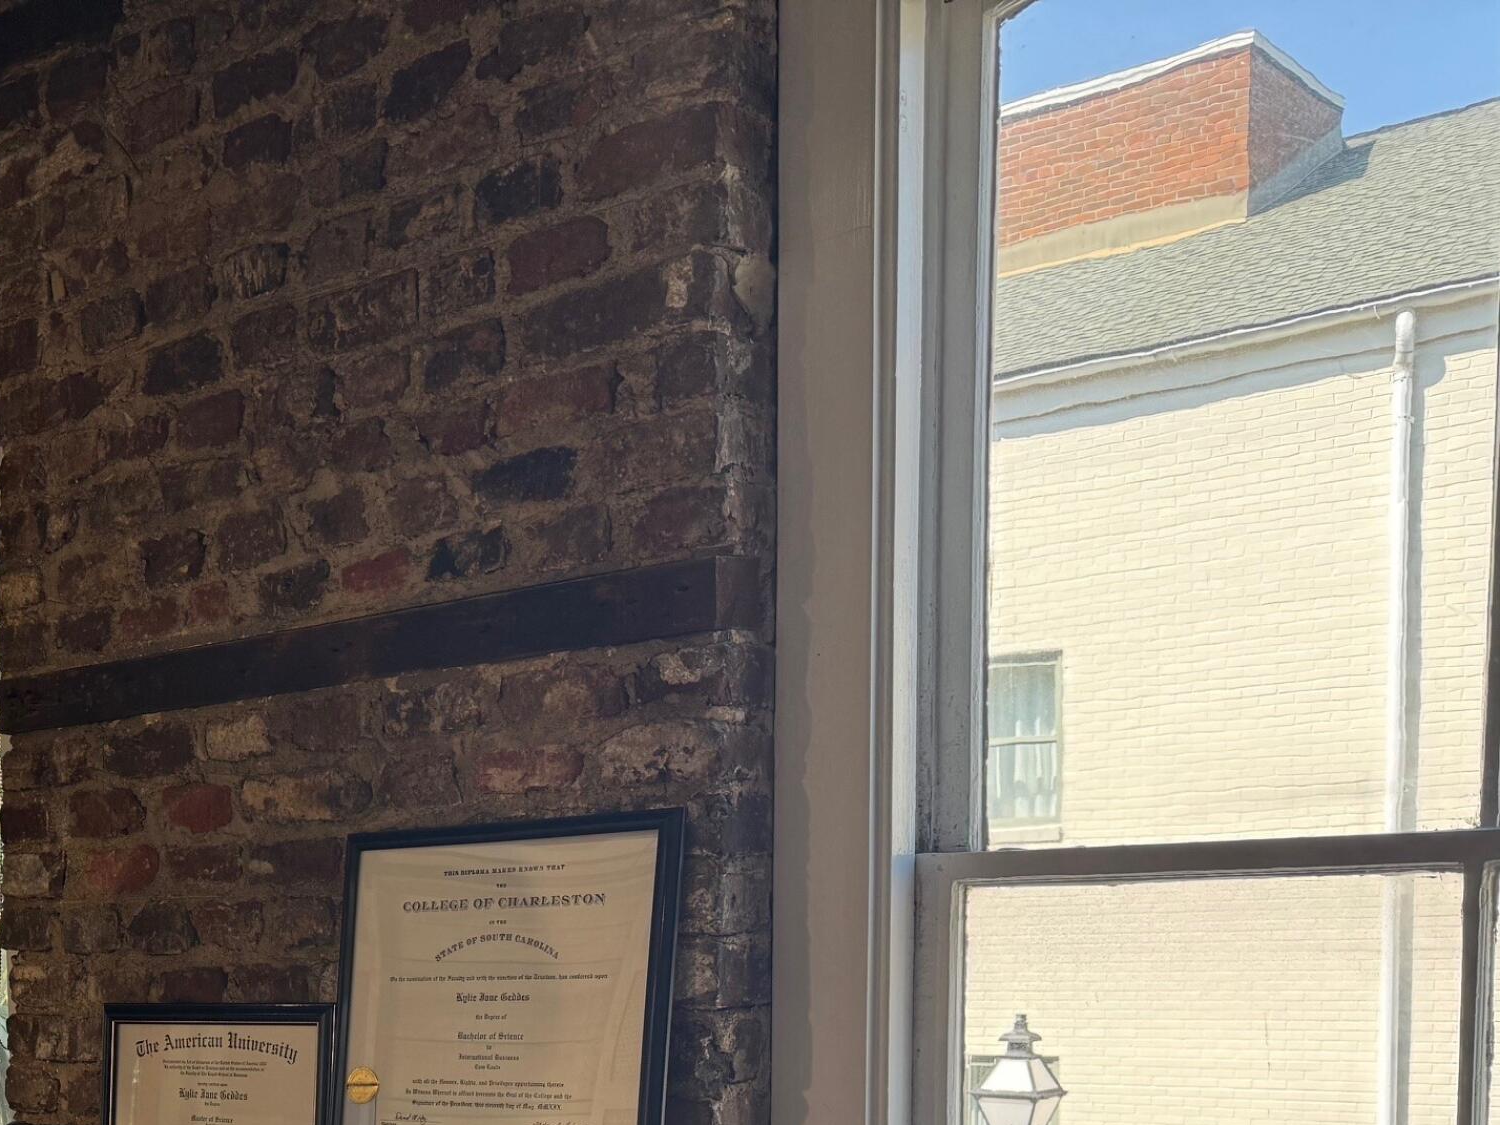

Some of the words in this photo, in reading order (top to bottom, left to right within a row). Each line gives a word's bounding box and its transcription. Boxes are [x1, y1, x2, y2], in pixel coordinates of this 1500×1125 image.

[402, 898, 468, 913] COLLEGE
[472, 898, 494, 910] OF
[497, 893, 606, 910] CHARLESTON
[434, 940, 464, 962] STATE
[466, 936, 478, 946] OF
[480, 933, 512, 943] SOUTH
[514, 934, 559, 960] CAROLINA
[457, 1031, 486, 1040] Bachelor
[489, 1032, 496, 1040] of
[498, 1032, 524, 1040] Science
[135, 1038, 160, 1057] The
[164, 1032, 223, 1051] American
[227, 1031, 298, 1065] University
